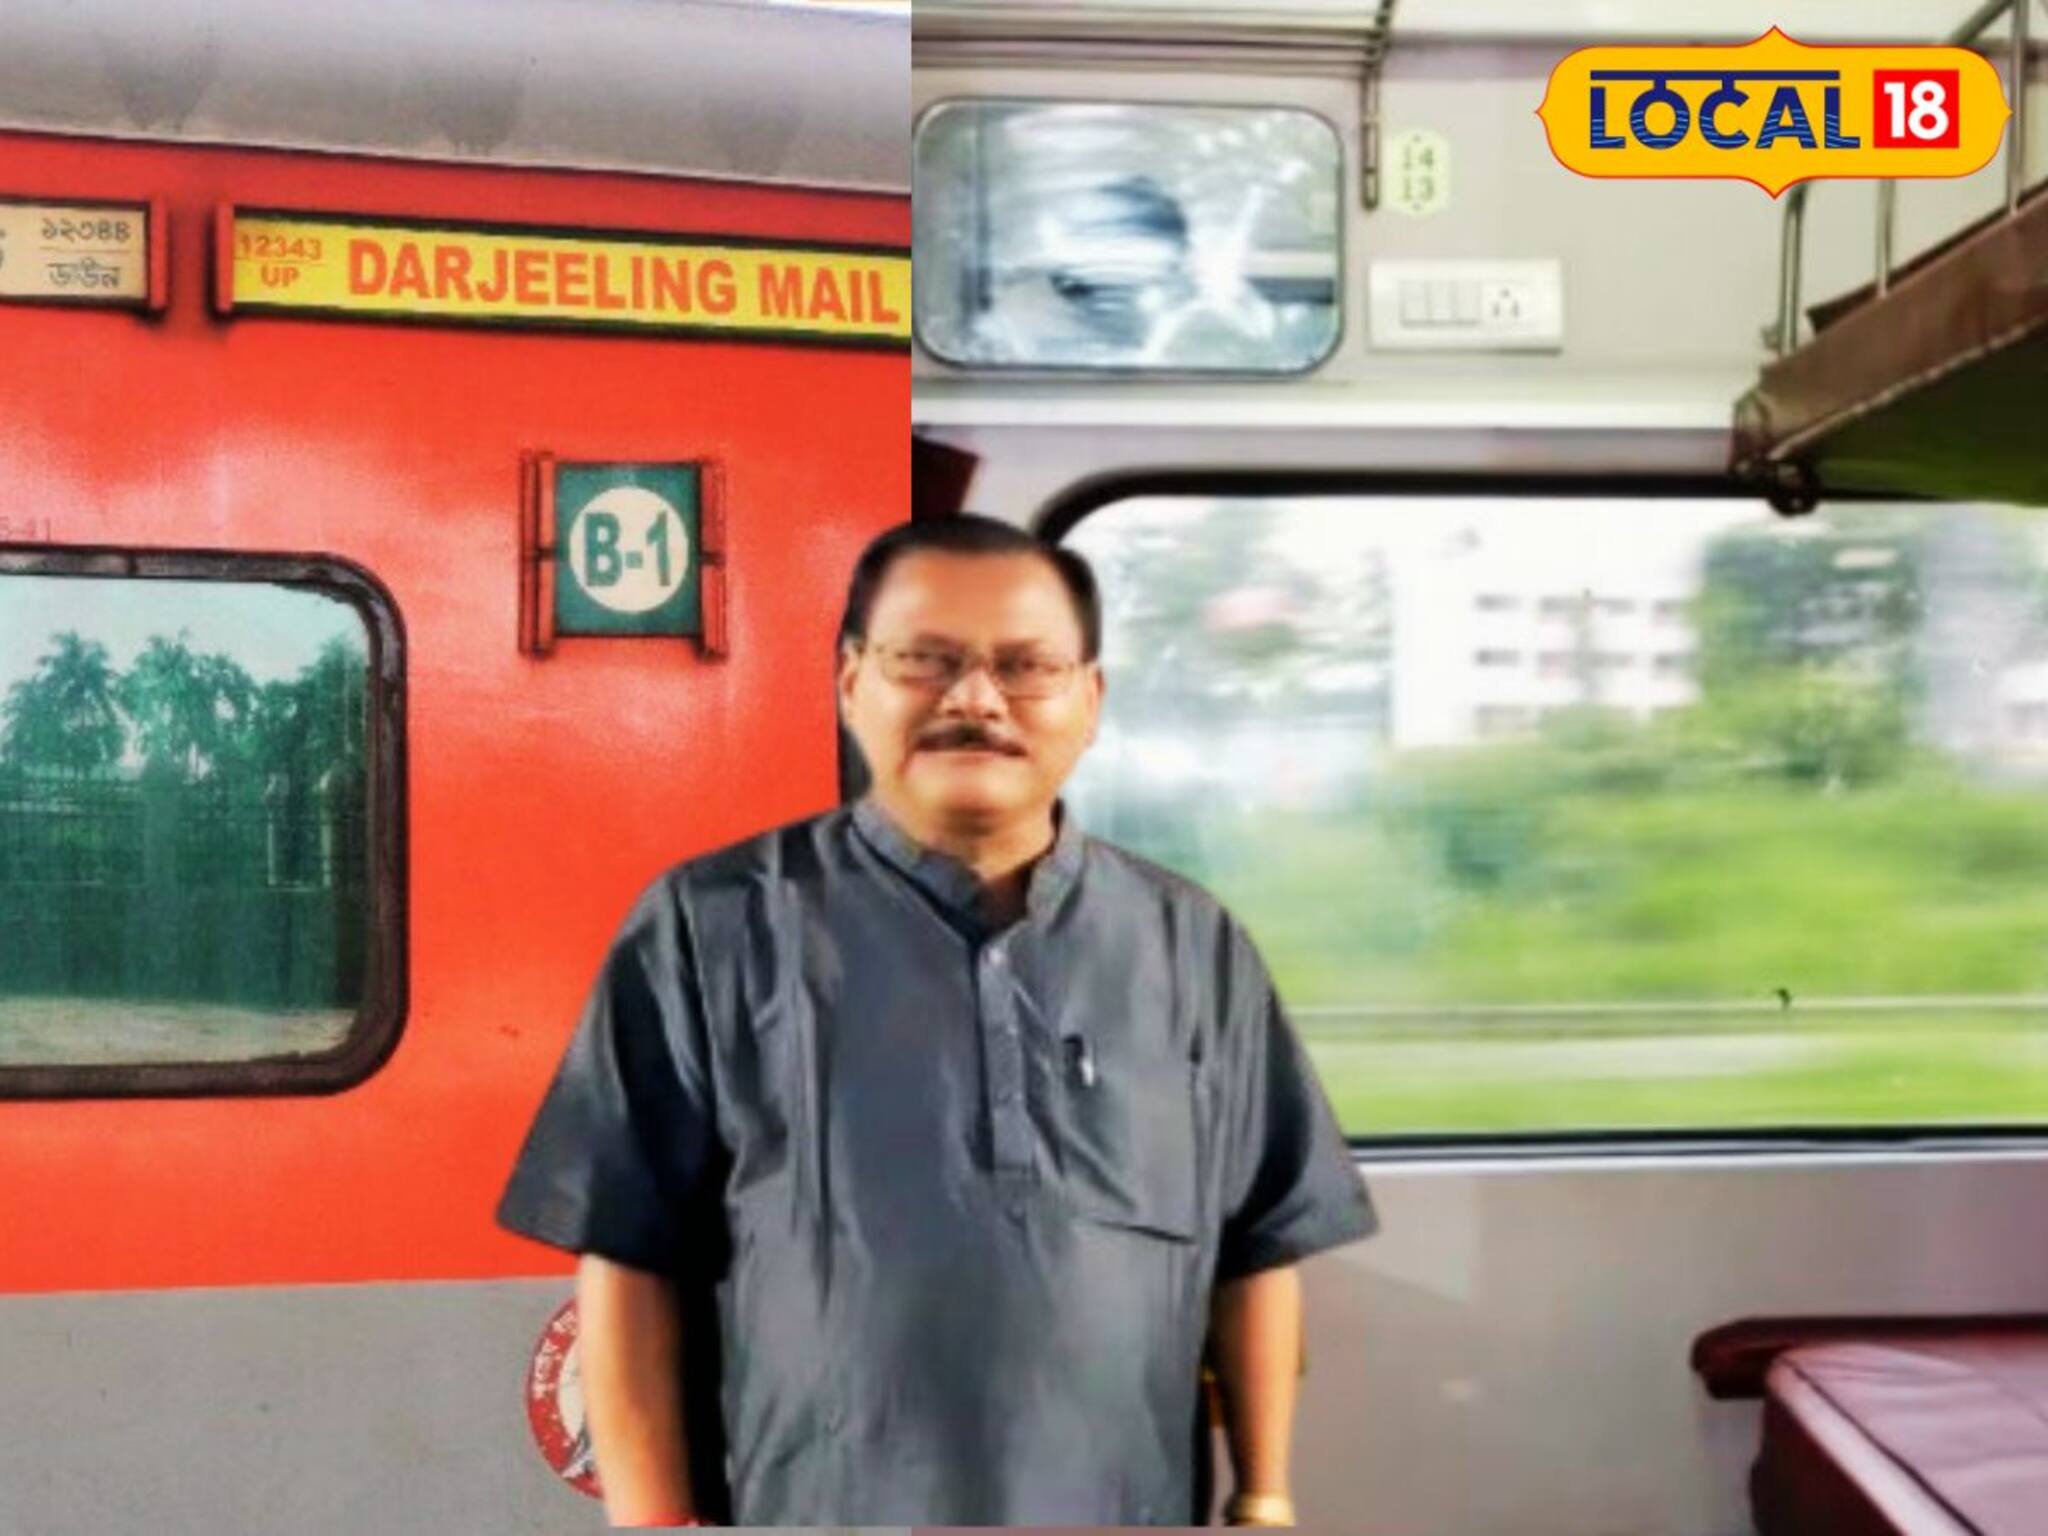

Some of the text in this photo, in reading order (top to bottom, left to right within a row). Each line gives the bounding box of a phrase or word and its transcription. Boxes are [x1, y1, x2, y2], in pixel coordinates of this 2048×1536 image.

[239, 235, 322, 260] 12343
[261, 264, 299, 288] UP
[348, 238, 900, 323] DARJEELING MAIL
[584, 510, 671, 587] B-1
